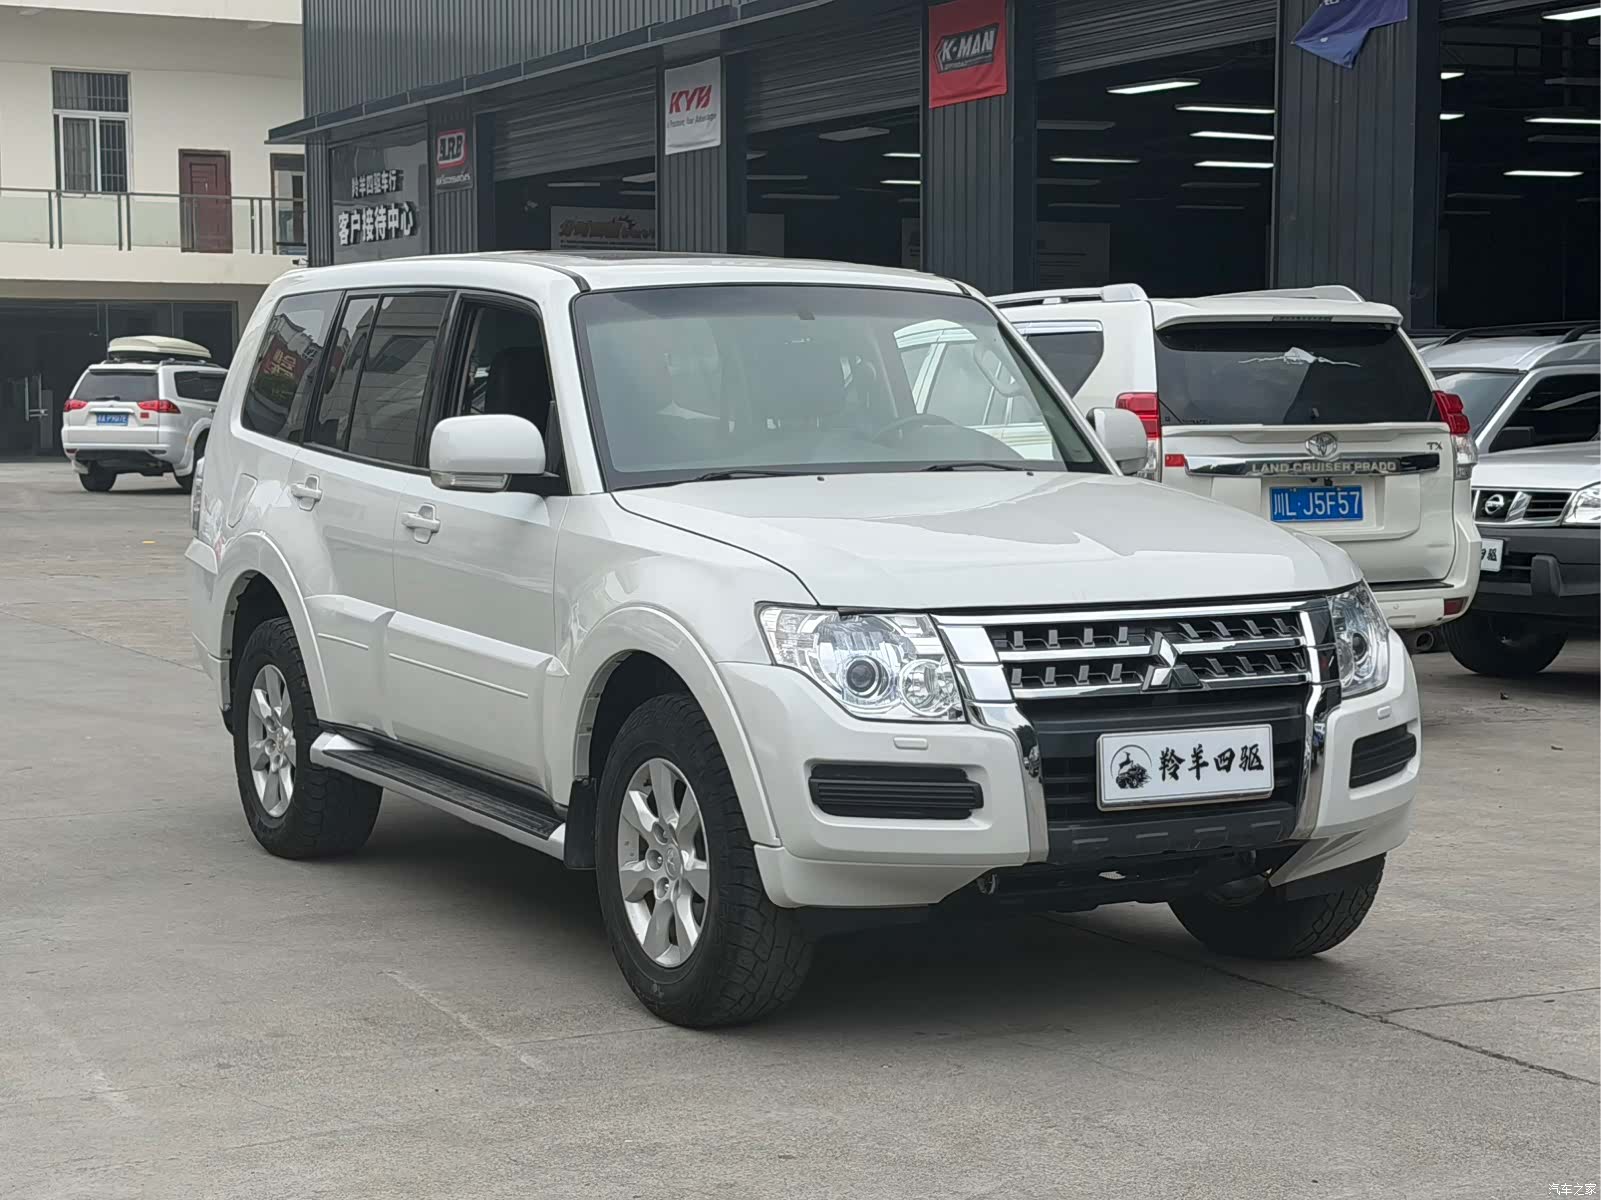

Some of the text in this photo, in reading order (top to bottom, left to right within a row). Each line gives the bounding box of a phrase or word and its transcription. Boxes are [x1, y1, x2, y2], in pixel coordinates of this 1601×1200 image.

[669, 84, 713, 114] KYB
[338, 201, 414, 246] 客户接待中心
[1427, 441, 1443, 451] TX
[1252, 460, 1397, 473] LAND CRUISER PRADO
[1158, 743, 1265, 782] 羚羊四驱
